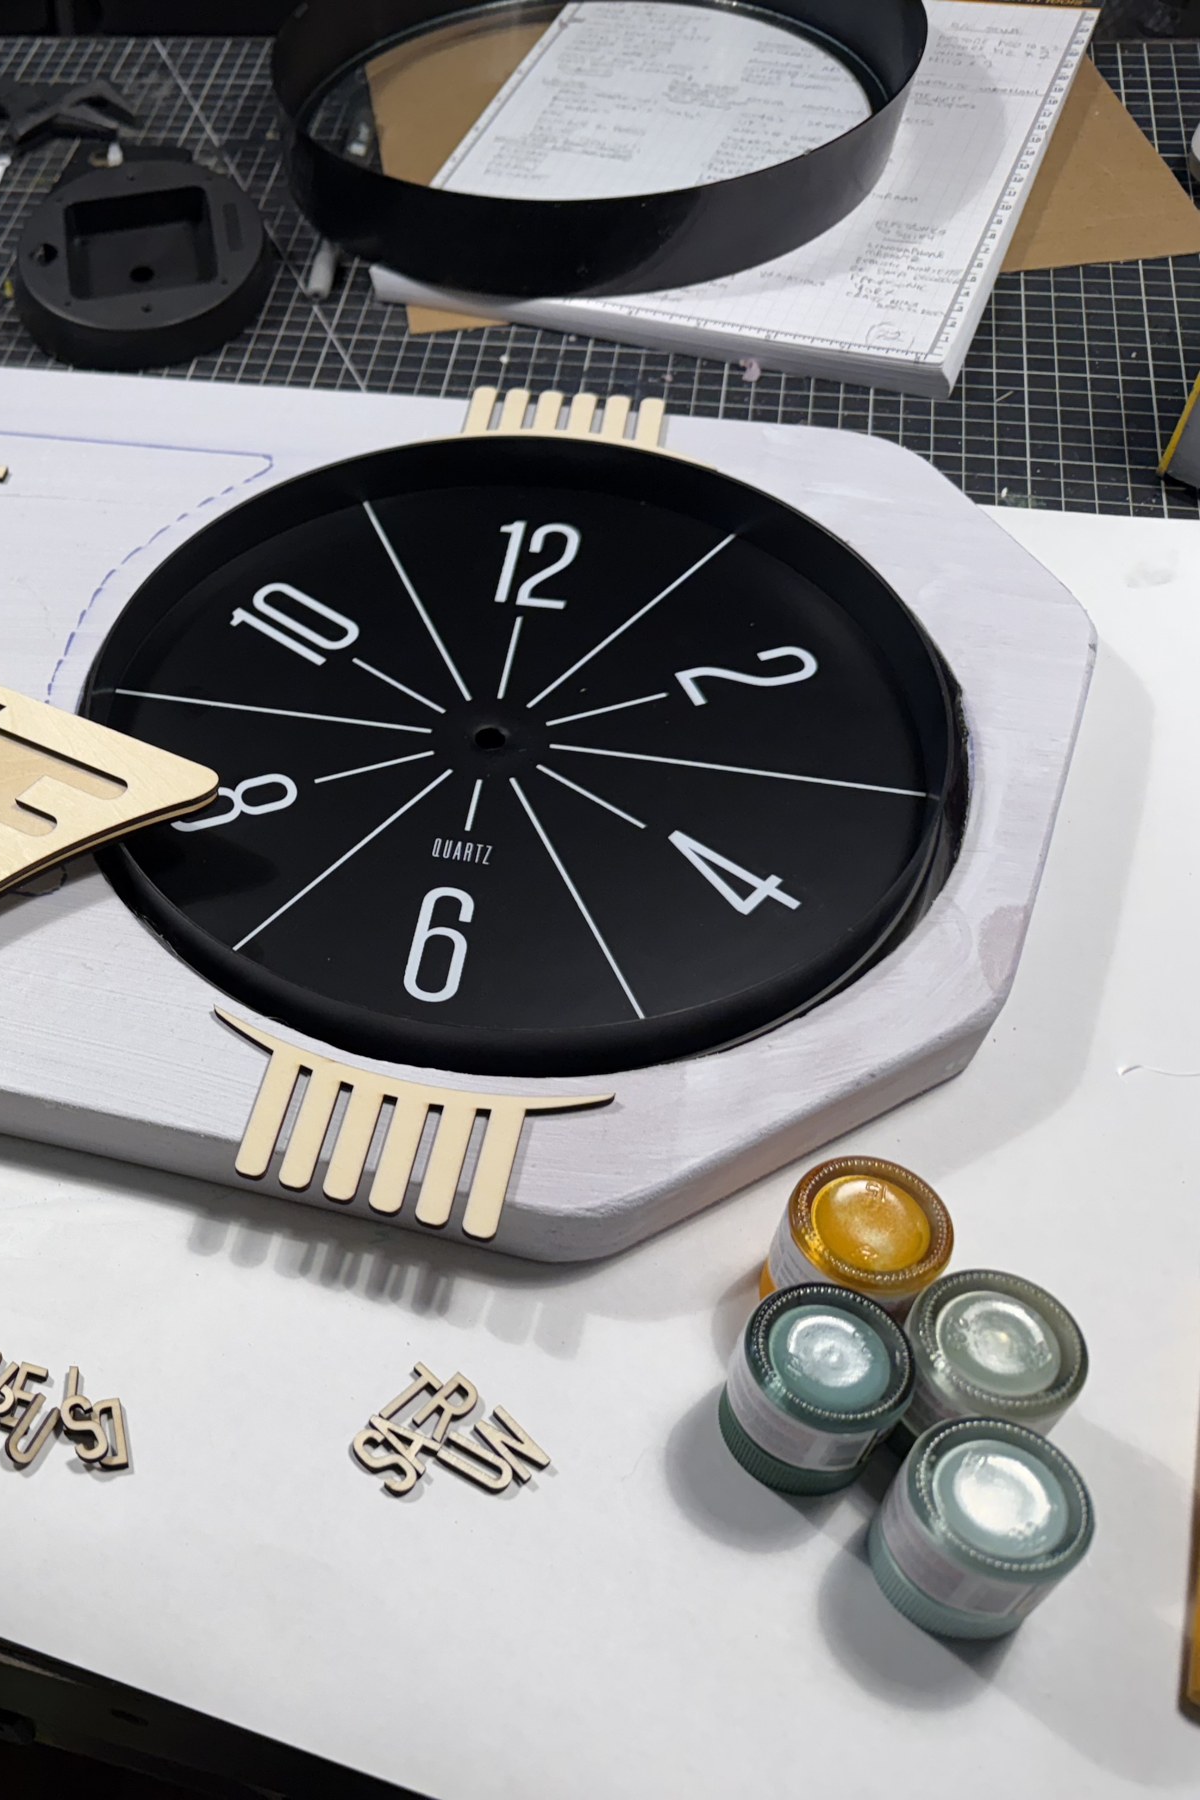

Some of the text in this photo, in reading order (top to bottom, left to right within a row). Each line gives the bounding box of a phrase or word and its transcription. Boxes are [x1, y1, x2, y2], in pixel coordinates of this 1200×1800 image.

[494, 520, 582, 610] 12
[230, 582, 360, 666] 10
[674, 646, 819, 707] 2
[169, 773, 298, 833] 8
[431, 837, 493, 866] QUARTZ
[667, 830, 802, 915] 4
[403, 887, 475, 1003] 6
